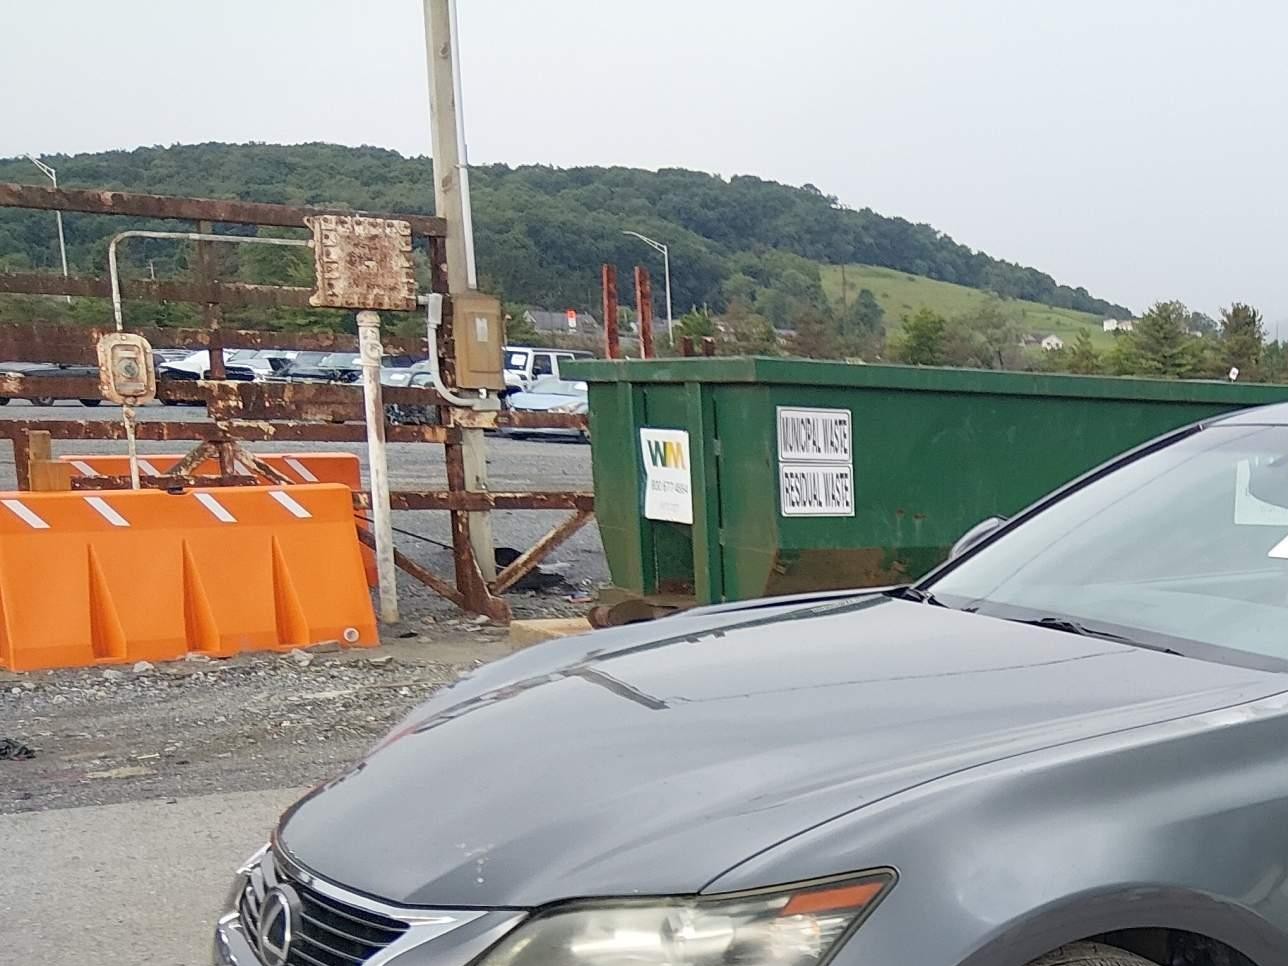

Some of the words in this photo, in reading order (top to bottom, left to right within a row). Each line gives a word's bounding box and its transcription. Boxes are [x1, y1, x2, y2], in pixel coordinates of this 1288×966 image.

[782, 416, 821, 453] MUNICIPAL
[822, 418, 848, 454] WASTE
[647, 439, 687, 470] WM
[784, 472, 823, 507] RESIDUAL
[823, 472, 850, 507] WASTE
